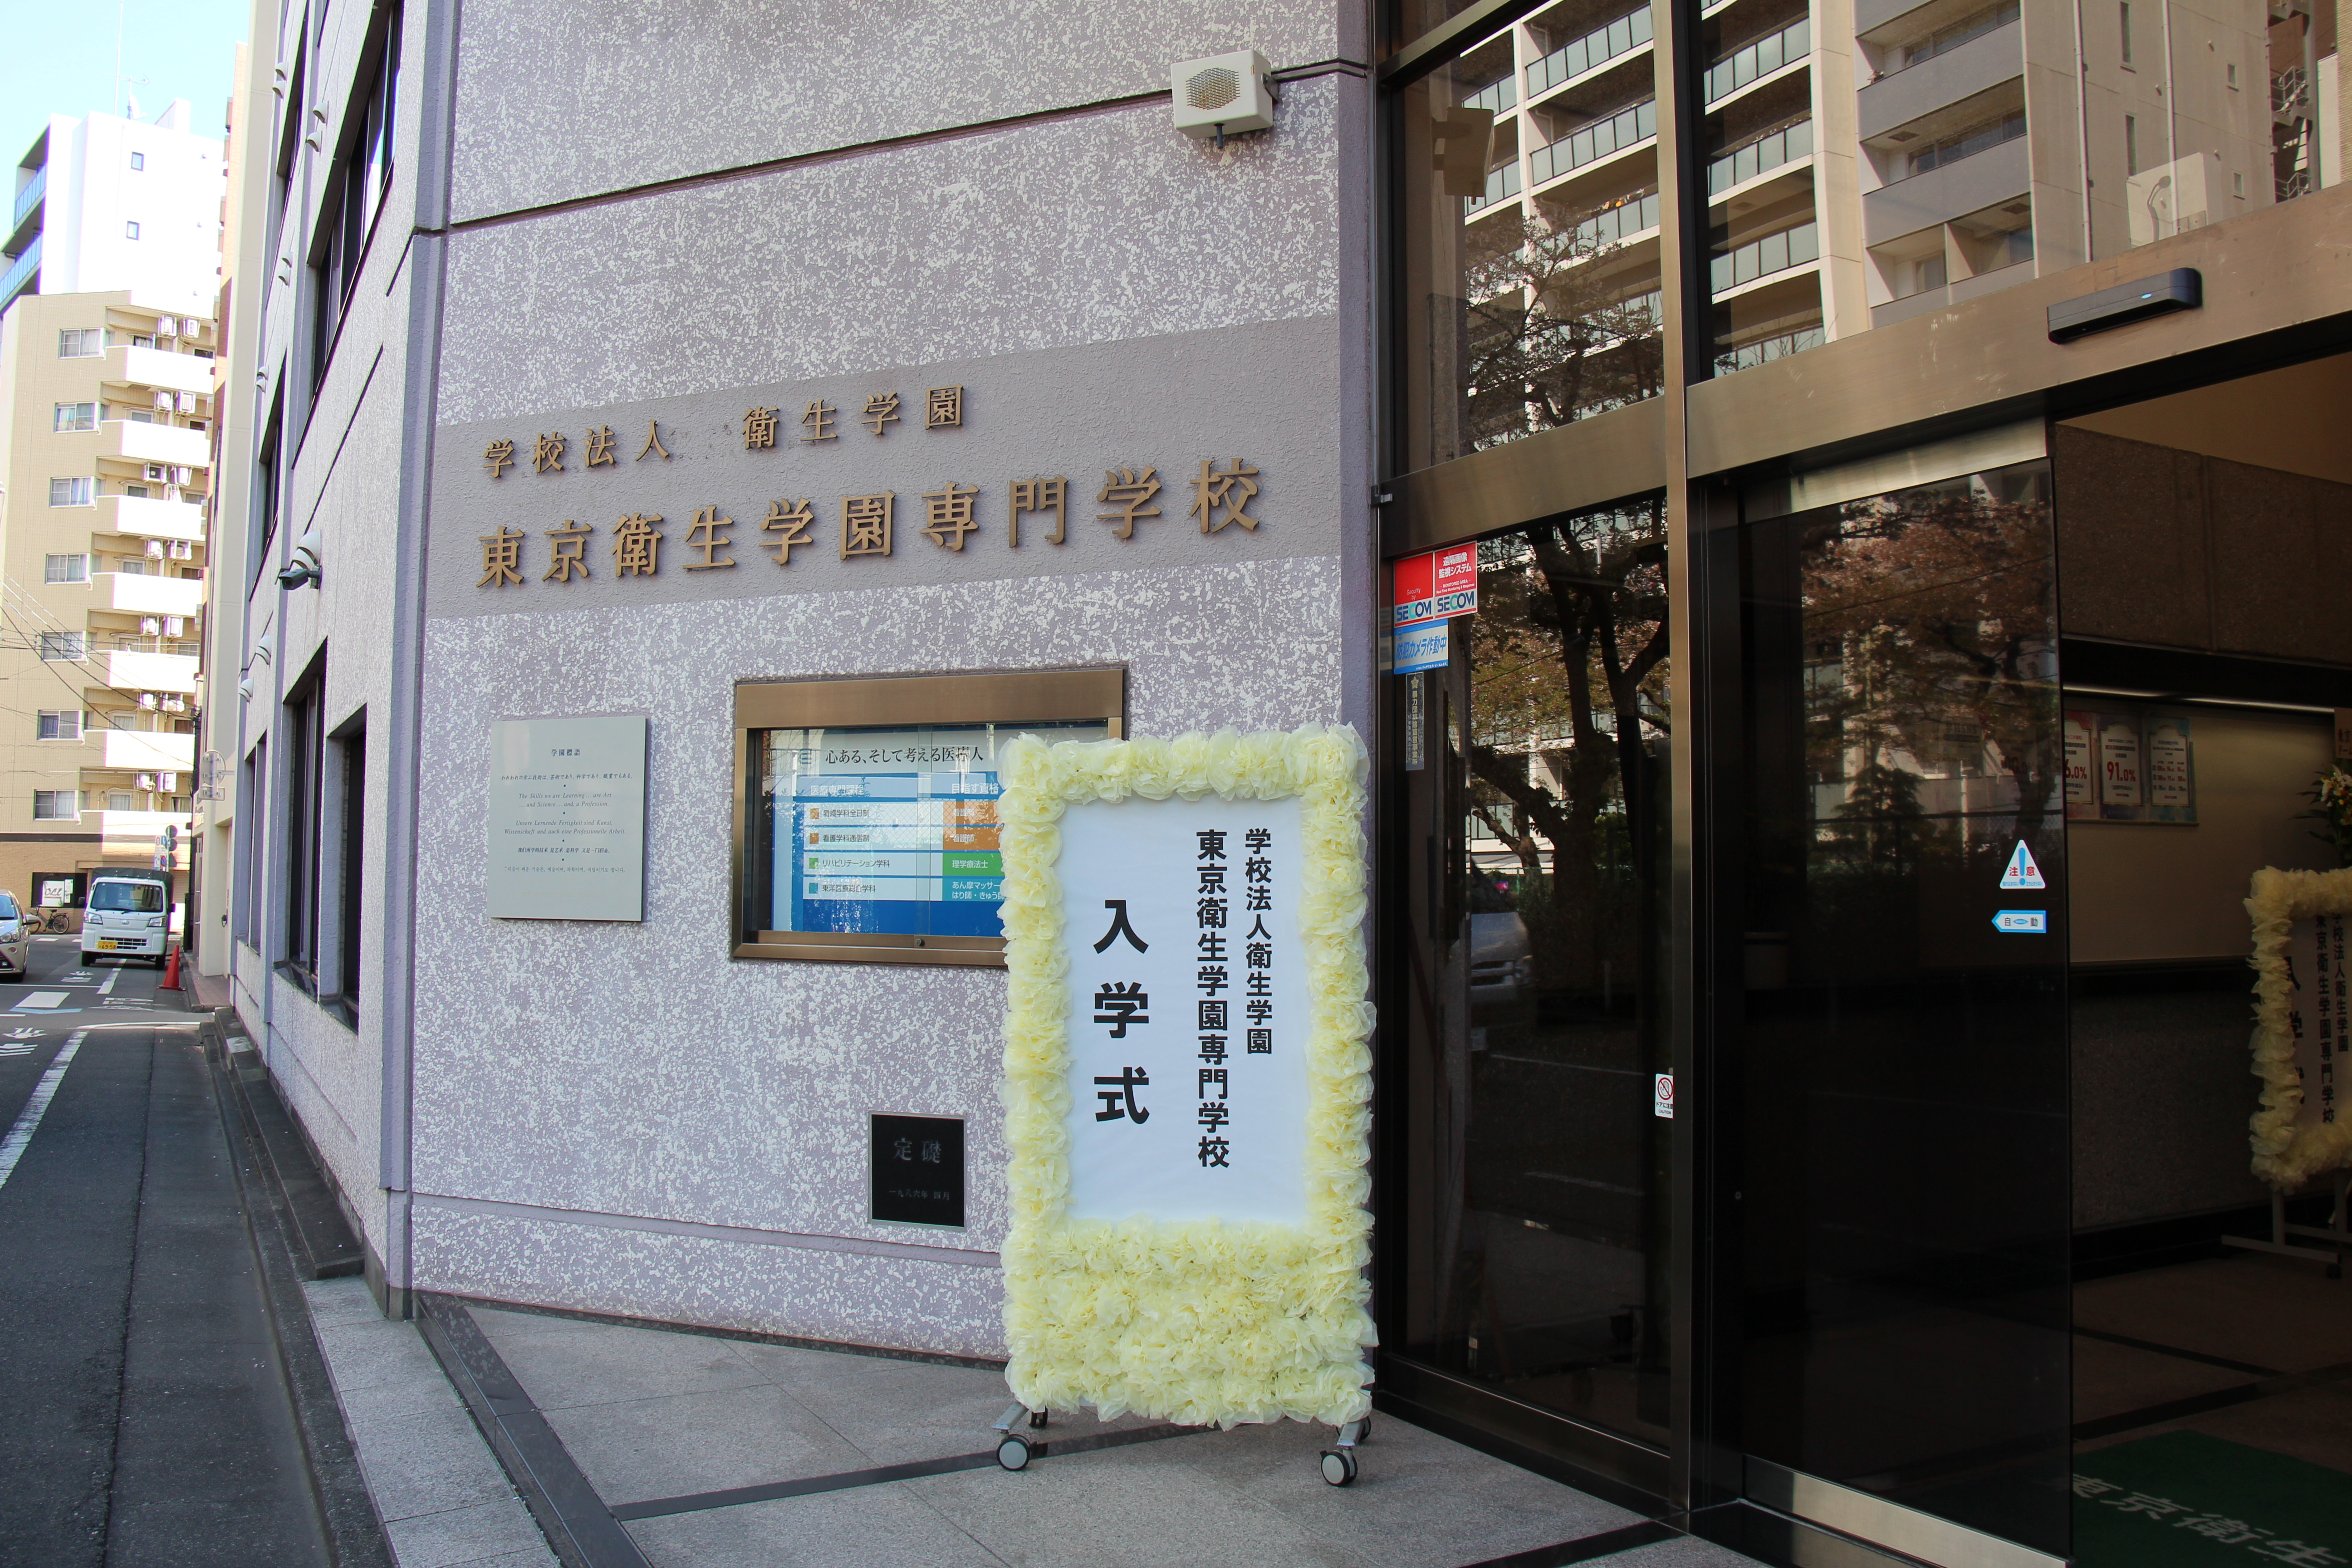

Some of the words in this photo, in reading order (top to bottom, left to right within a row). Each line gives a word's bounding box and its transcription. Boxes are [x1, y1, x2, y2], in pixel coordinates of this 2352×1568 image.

[484, 420, 671, 478] 学校法人
[742, 384, 964, 450] 衛生学園
[475, 458, 1259, 589] 東京衛生学園専門学校
[1443, 552, 1467, 566] 遠隔画像
[1439, 563, 1472, 578] 監視システム
[1397, 600, 1431, 622] SECOM
[1437, 591, 1474, 612] SECOM
[1396, 634, 1447, 660] 防犯カメラ作動中
[826, 747, 984, 764] 心ある、そして考える医療人
[2107, 761, 2136, 782] 91.0%
[811, 785, 863, 796] 医療専門課程
[951, 783, 999, 794] 目指す資格
[822, 884, 876, 892] 東洋医療総合学科
[1245, 828, 1272, 1054] 学校法人衛生学園
[1196, 829, 1230, 1168] 東京衛生学園専門学校
[1093, 899, 1149, 1124] 入学式
[893, 1137, 941, 1163] 定礎
[933, 1191, 950, 1200] 四月
